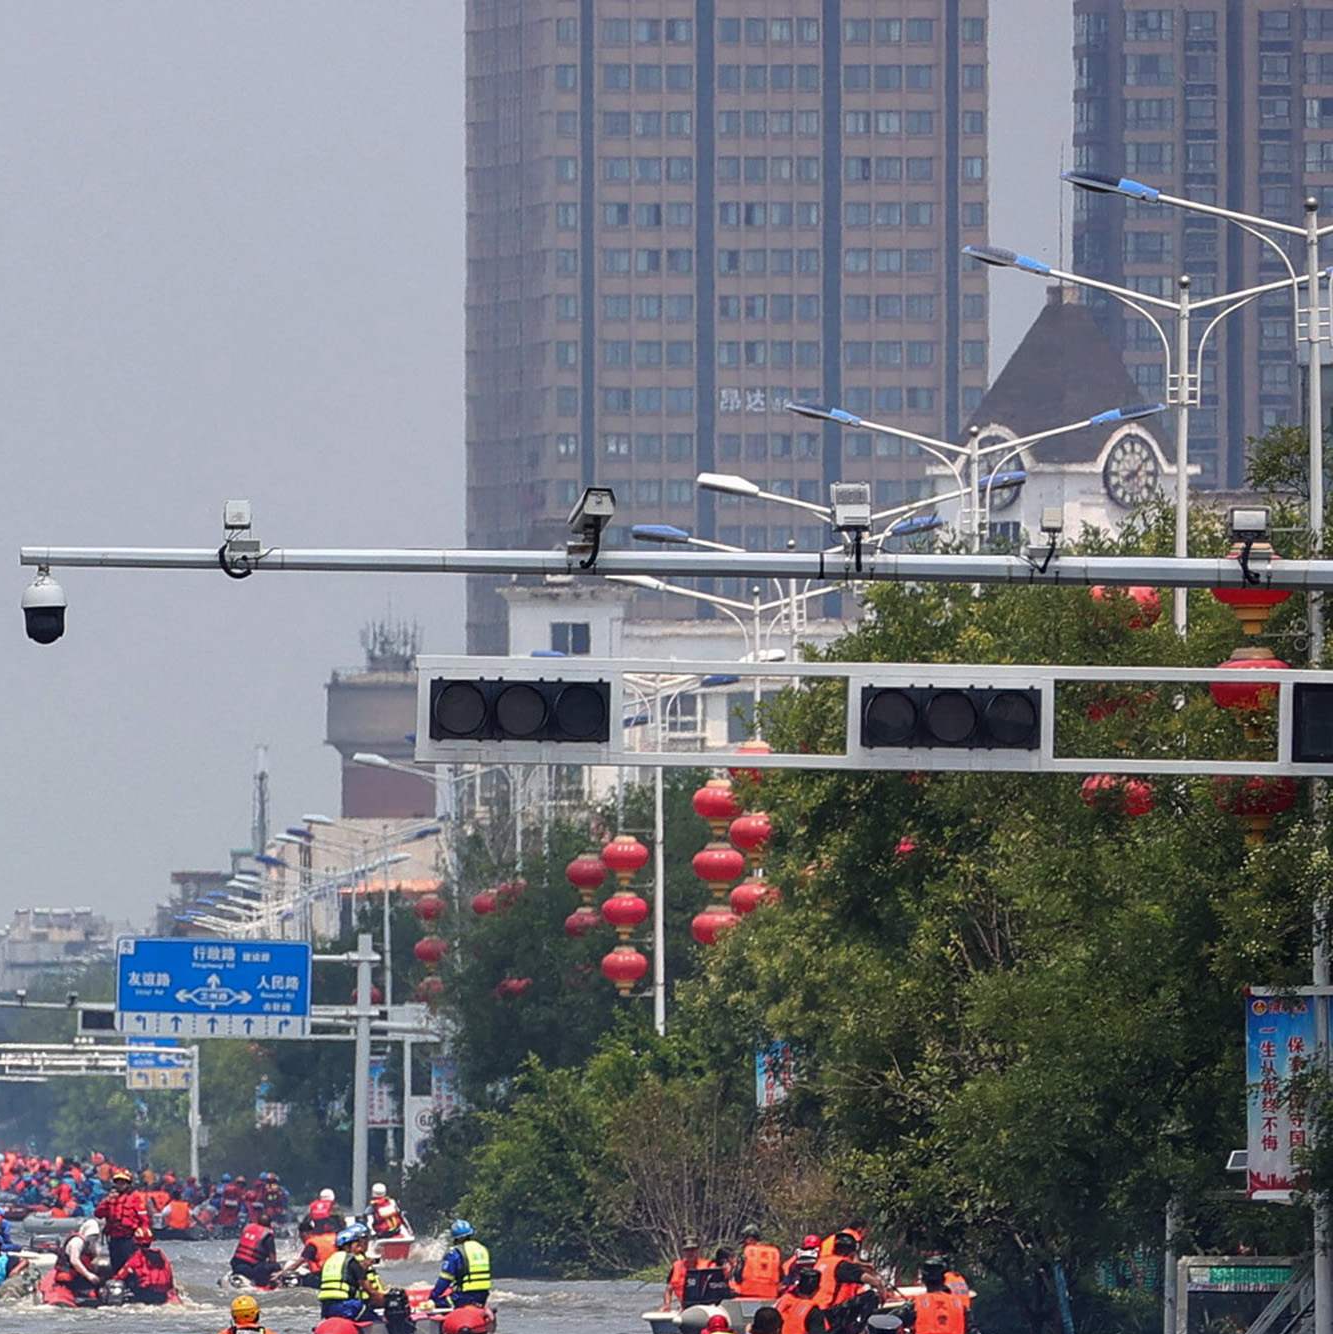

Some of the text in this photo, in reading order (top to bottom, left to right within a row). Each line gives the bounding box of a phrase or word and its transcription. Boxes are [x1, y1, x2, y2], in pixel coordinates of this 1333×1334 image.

[256, 975, 299, 991] 人民路
[1259, 1026, 1278, 1152] 一生从军终不悔
